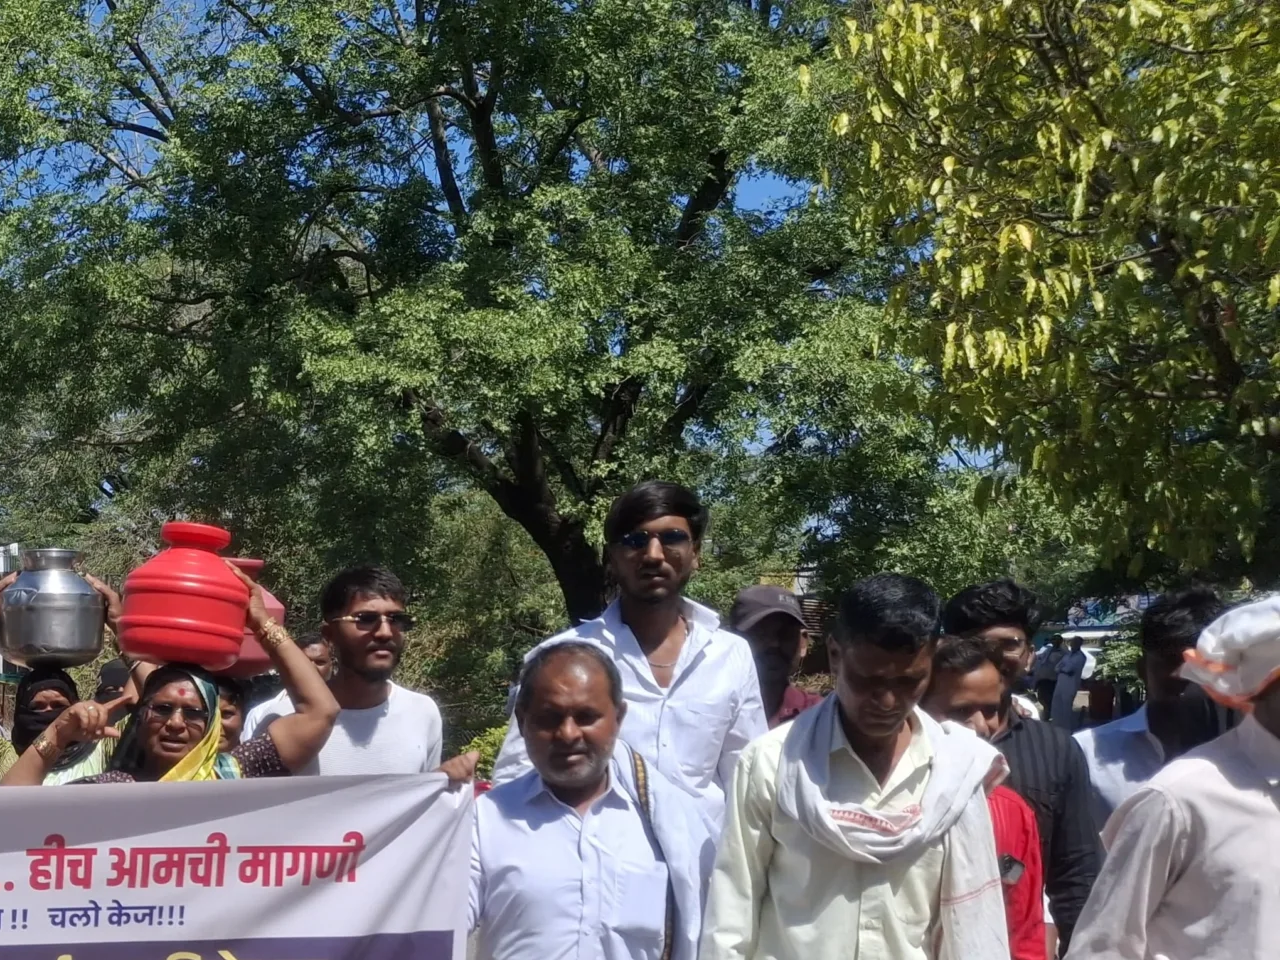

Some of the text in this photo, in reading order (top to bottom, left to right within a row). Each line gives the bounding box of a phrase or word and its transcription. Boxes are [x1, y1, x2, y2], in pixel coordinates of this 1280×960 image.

[26, 833, 97, 891] हीच
[106, 832, 230, 888] आमची
[237, 831, 366, 885] मागणी
[47, 900, 101, 929] चलो
